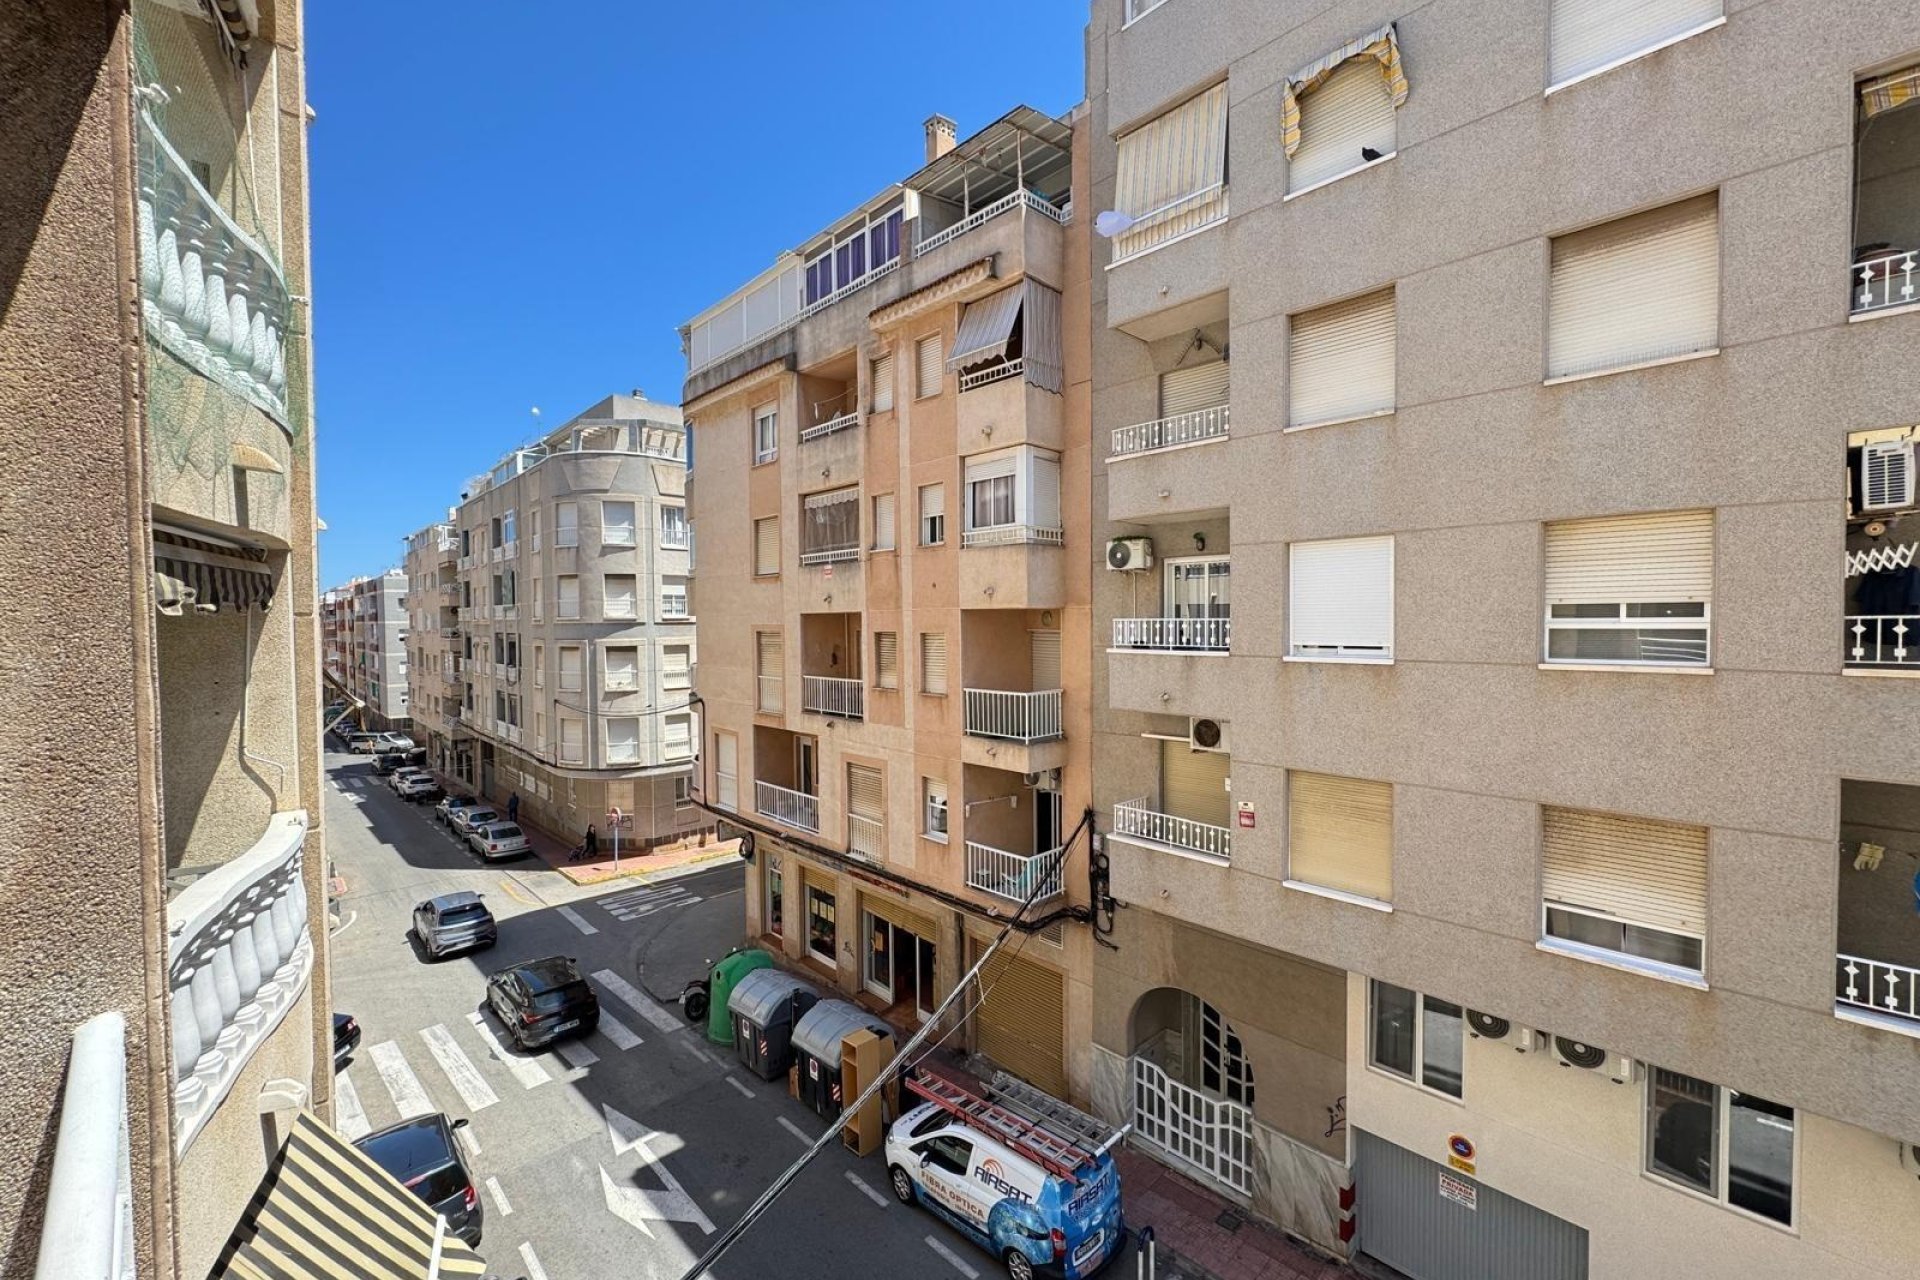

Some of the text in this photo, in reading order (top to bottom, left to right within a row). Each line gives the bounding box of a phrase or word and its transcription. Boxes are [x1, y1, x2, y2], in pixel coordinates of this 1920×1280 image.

[921, 1170, 947, 1194] FIBRA
[949, 1189, 985, 1219] OPTICA
[974, 1166, 1032, 1205] AIRSAT
